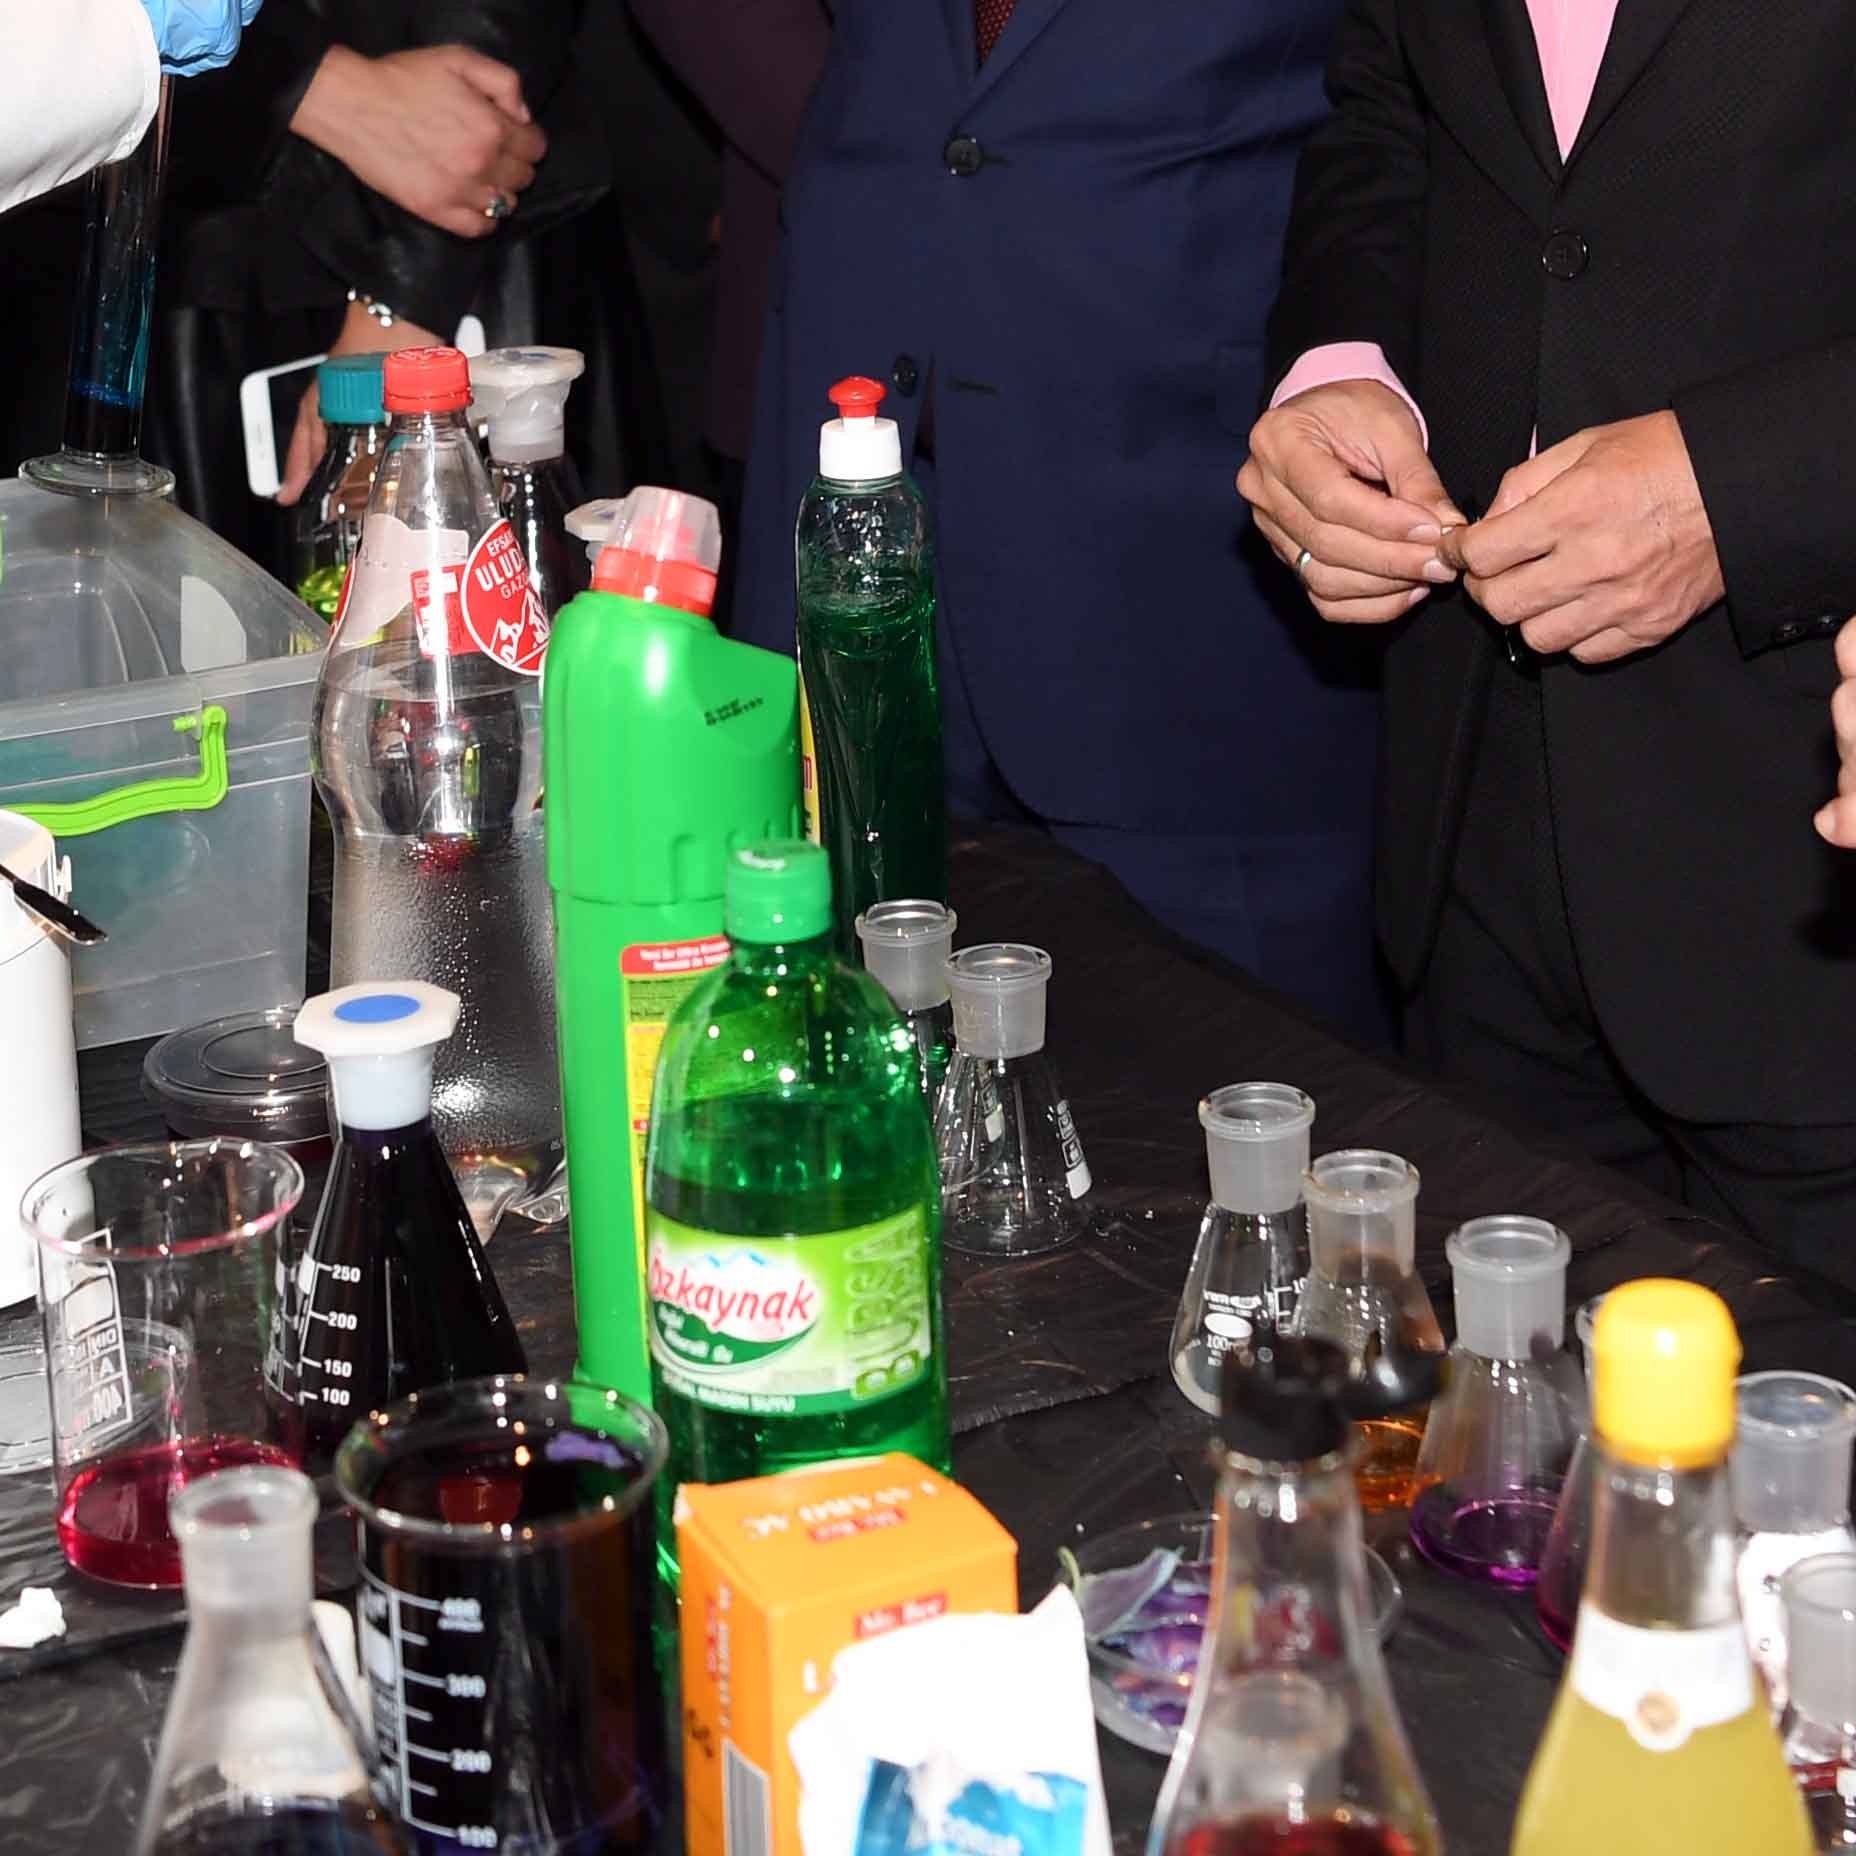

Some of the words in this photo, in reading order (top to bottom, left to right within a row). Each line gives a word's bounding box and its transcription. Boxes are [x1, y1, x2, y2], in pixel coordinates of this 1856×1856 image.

[475, 547, 526, 592] ULUD
[332, 1264, 361, 1283] 250
[844, 1208, 922, 1401] BURSA
[327, 1311, 358, 1331] 200
[323, 1358, 353, 1378] 150
[321, 1387, 350, 1406] 100
[446, 1673, 487, 1699] 300
[451, 1748, 492, 1774] 200
[458, 1825, 498, 1849] 100
